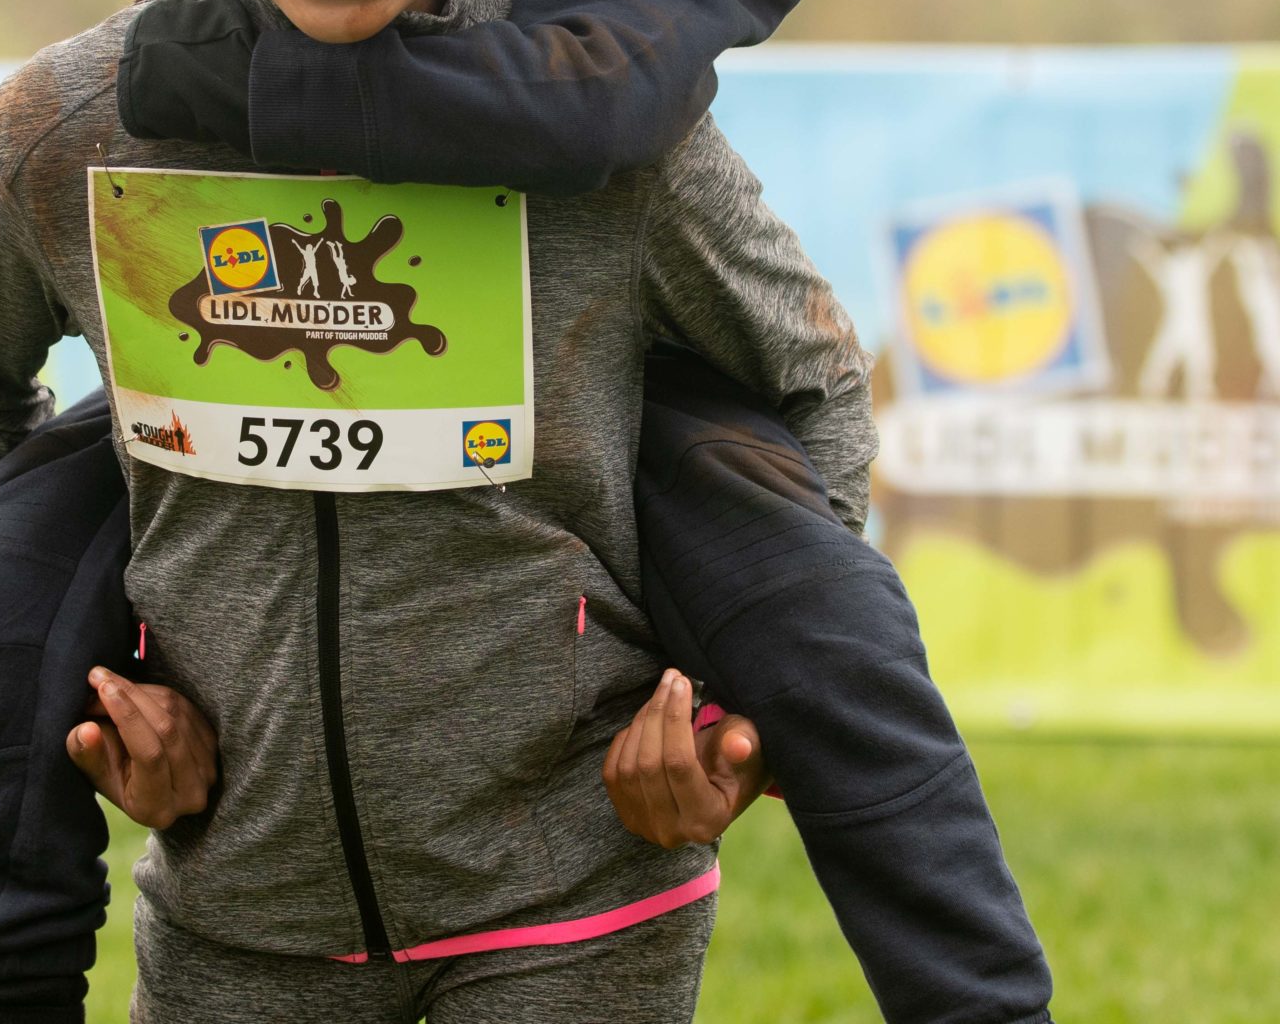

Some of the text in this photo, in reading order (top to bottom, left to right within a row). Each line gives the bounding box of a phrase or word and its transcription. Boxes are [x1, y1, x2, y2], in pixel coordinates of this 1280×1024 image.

[210, 300, 383, 326] LIDL MUDDER
[305, 331, 388, 341] PART OF TOUGH MUDDER
[237, 416, 384, 470] 5739
